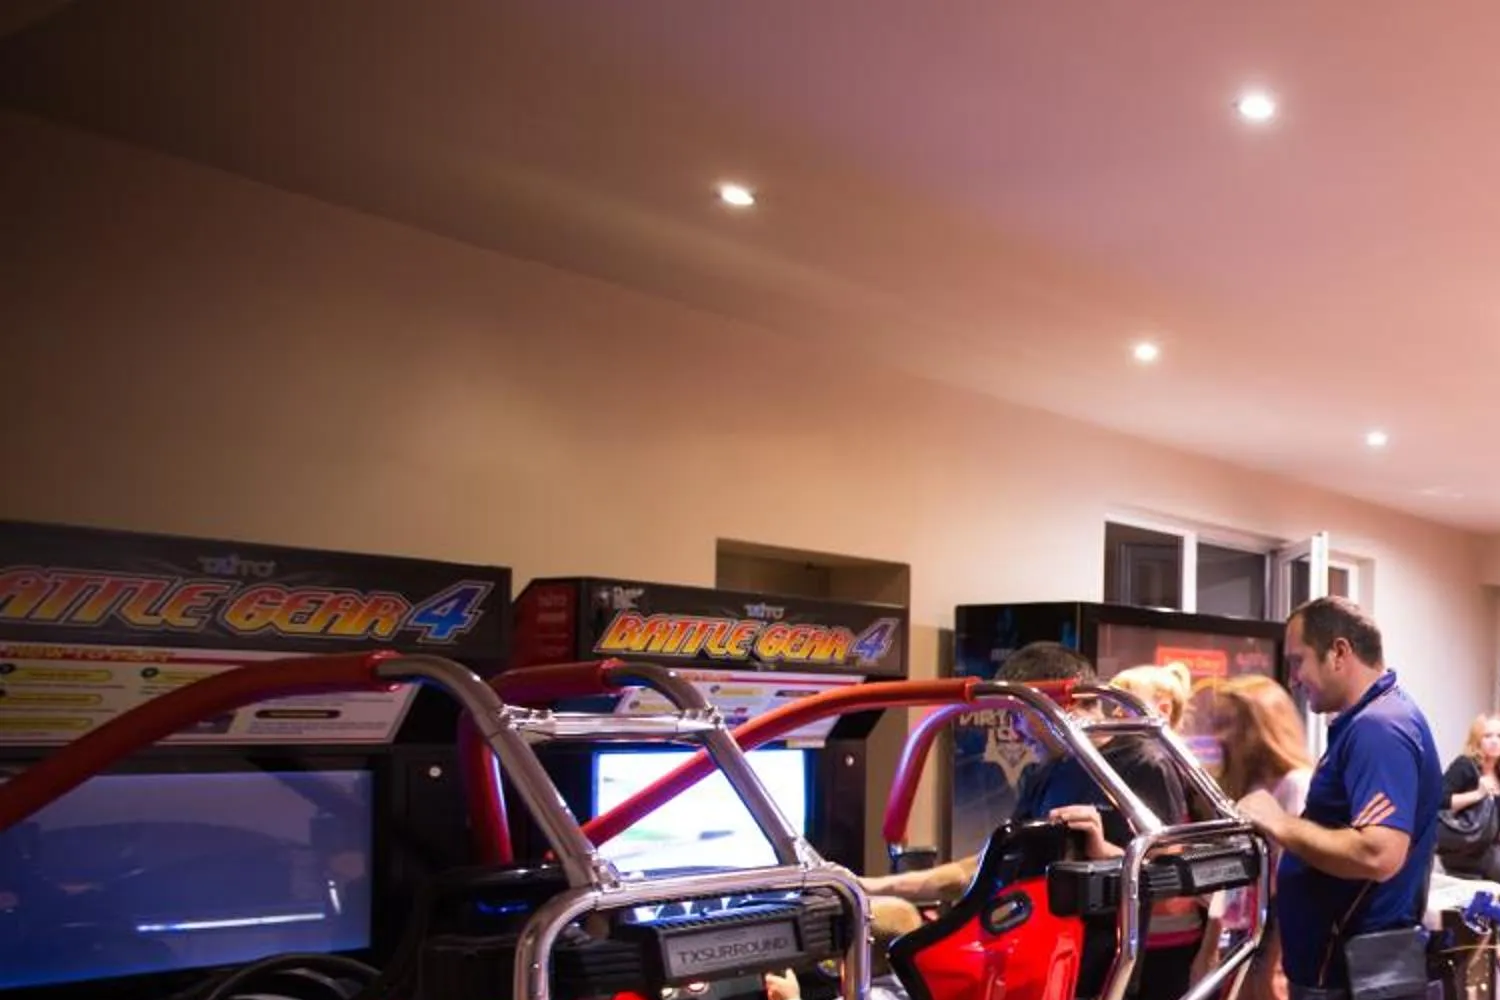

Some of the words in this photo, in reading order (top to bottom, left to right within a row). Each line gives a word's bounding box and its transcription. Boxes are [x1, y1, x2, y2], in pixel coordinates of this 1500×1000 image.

[0, 566, 240, 629] ATTLE
[218, 583, 411, 641] GEAR
[400, 580, 495, 644] 4
[593, 611, 767, 660] BATTLE
[754, 622, 856, 664] GEAR
[849, 616, 900, 667] 4
